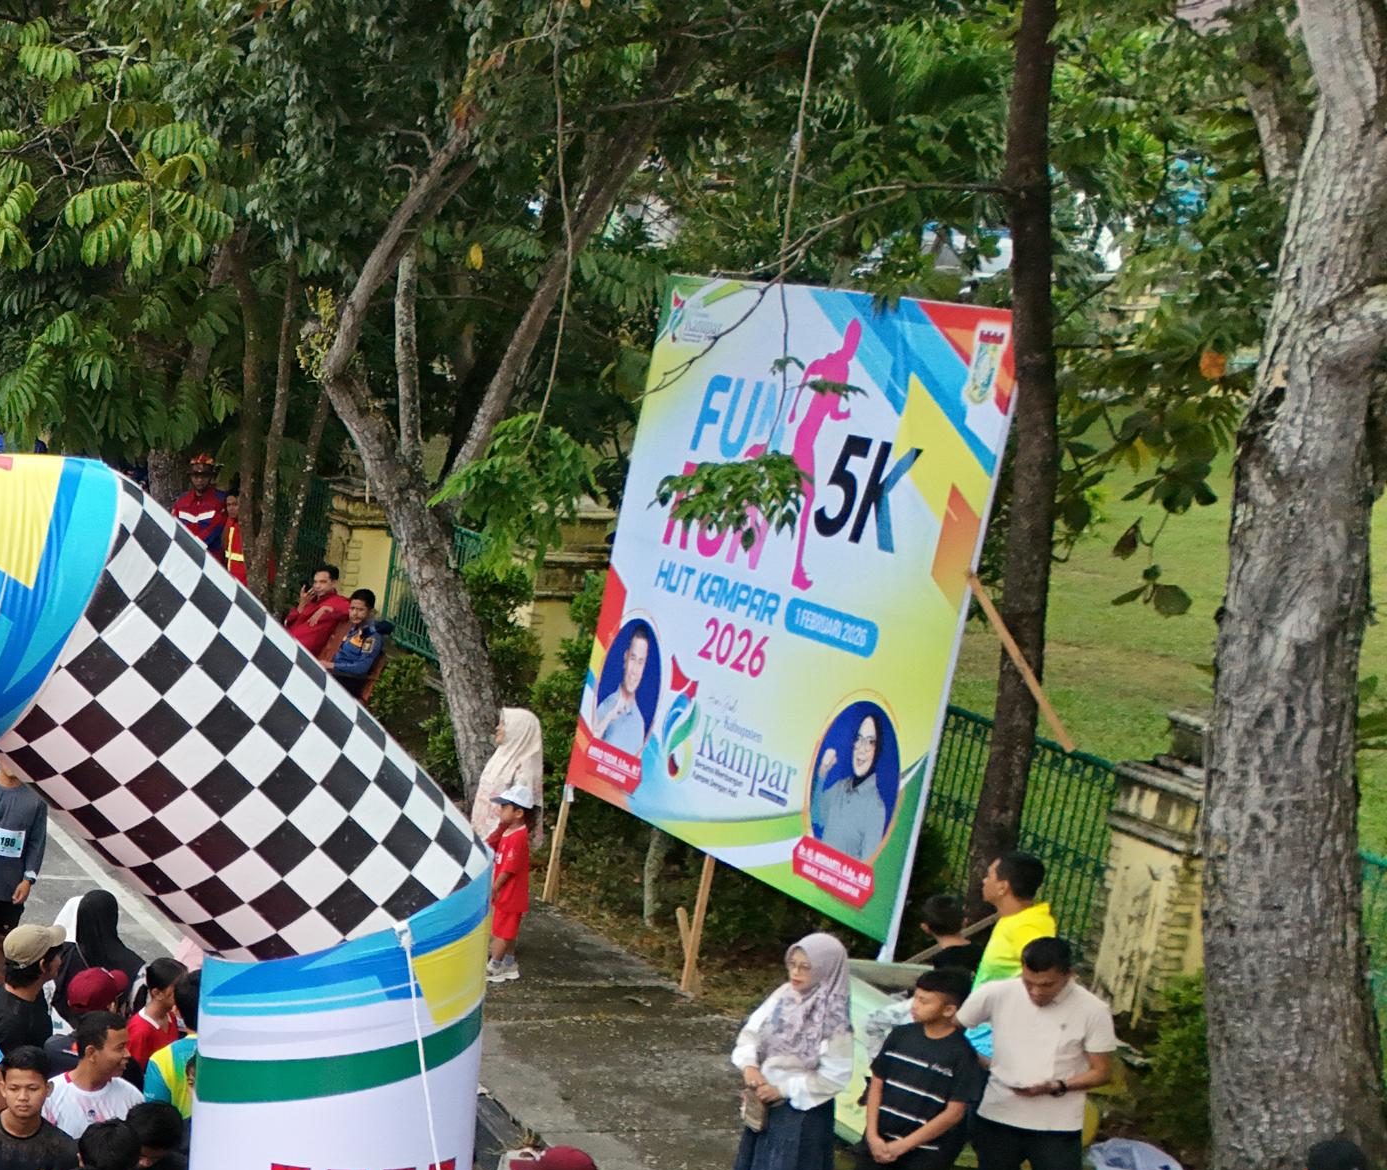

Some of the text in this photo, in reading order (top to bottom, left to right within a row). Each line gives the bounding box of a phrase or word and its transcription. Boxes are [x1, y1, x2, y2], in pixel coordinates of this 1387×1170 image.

[815, 433, 924, 554] 5K
[654, 559, 782, 626] HUT KAMPAR
[697, 617, 770, 679] 2026
[840, 623, 869, 648] 2026
[697, 714, 797, 798] Kampar
